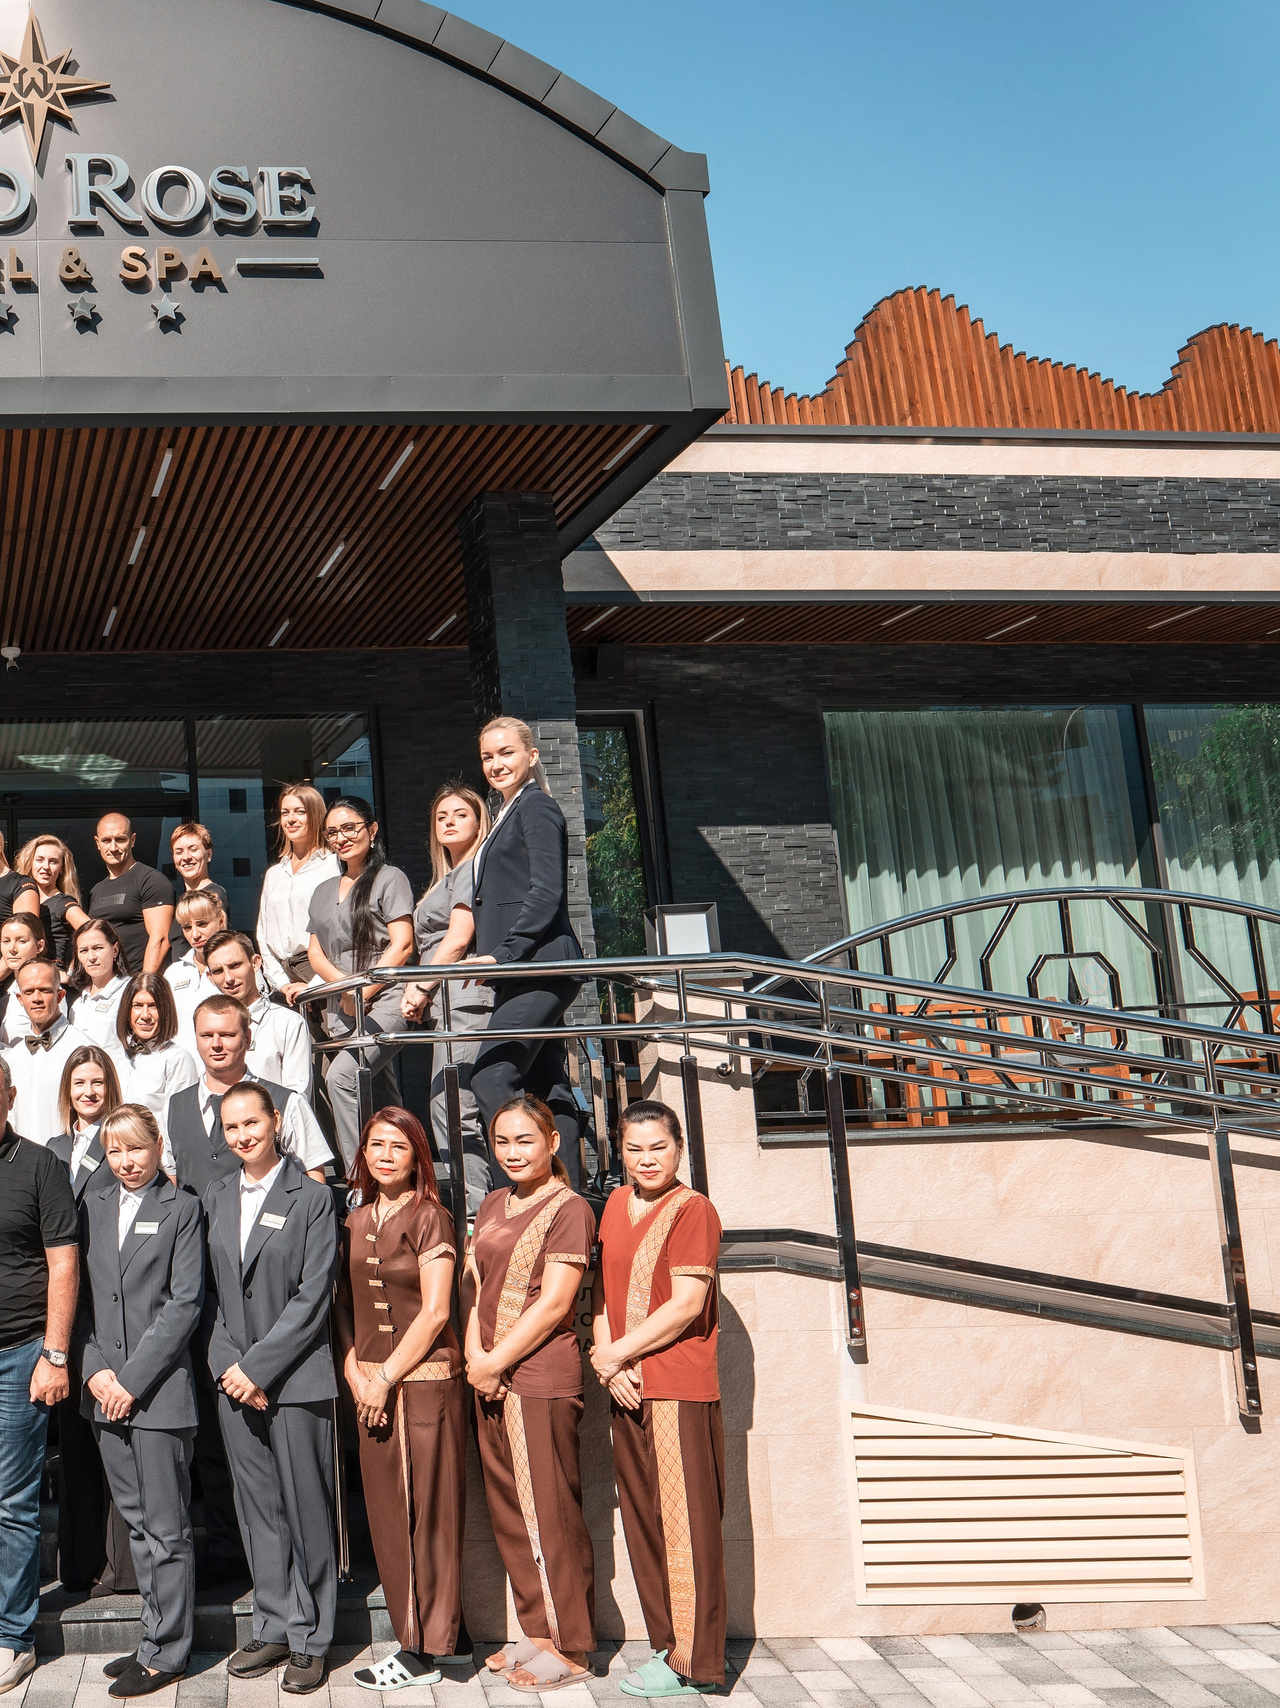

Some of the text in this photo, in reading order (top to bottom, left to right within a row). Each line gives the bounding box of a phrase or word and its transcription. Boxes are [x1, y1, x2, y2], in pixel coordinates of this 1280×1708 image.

[65, 153, 316, 227] ROSE
[58, 246, 93, 282] &
[120, 246, 222, 282] SPA
